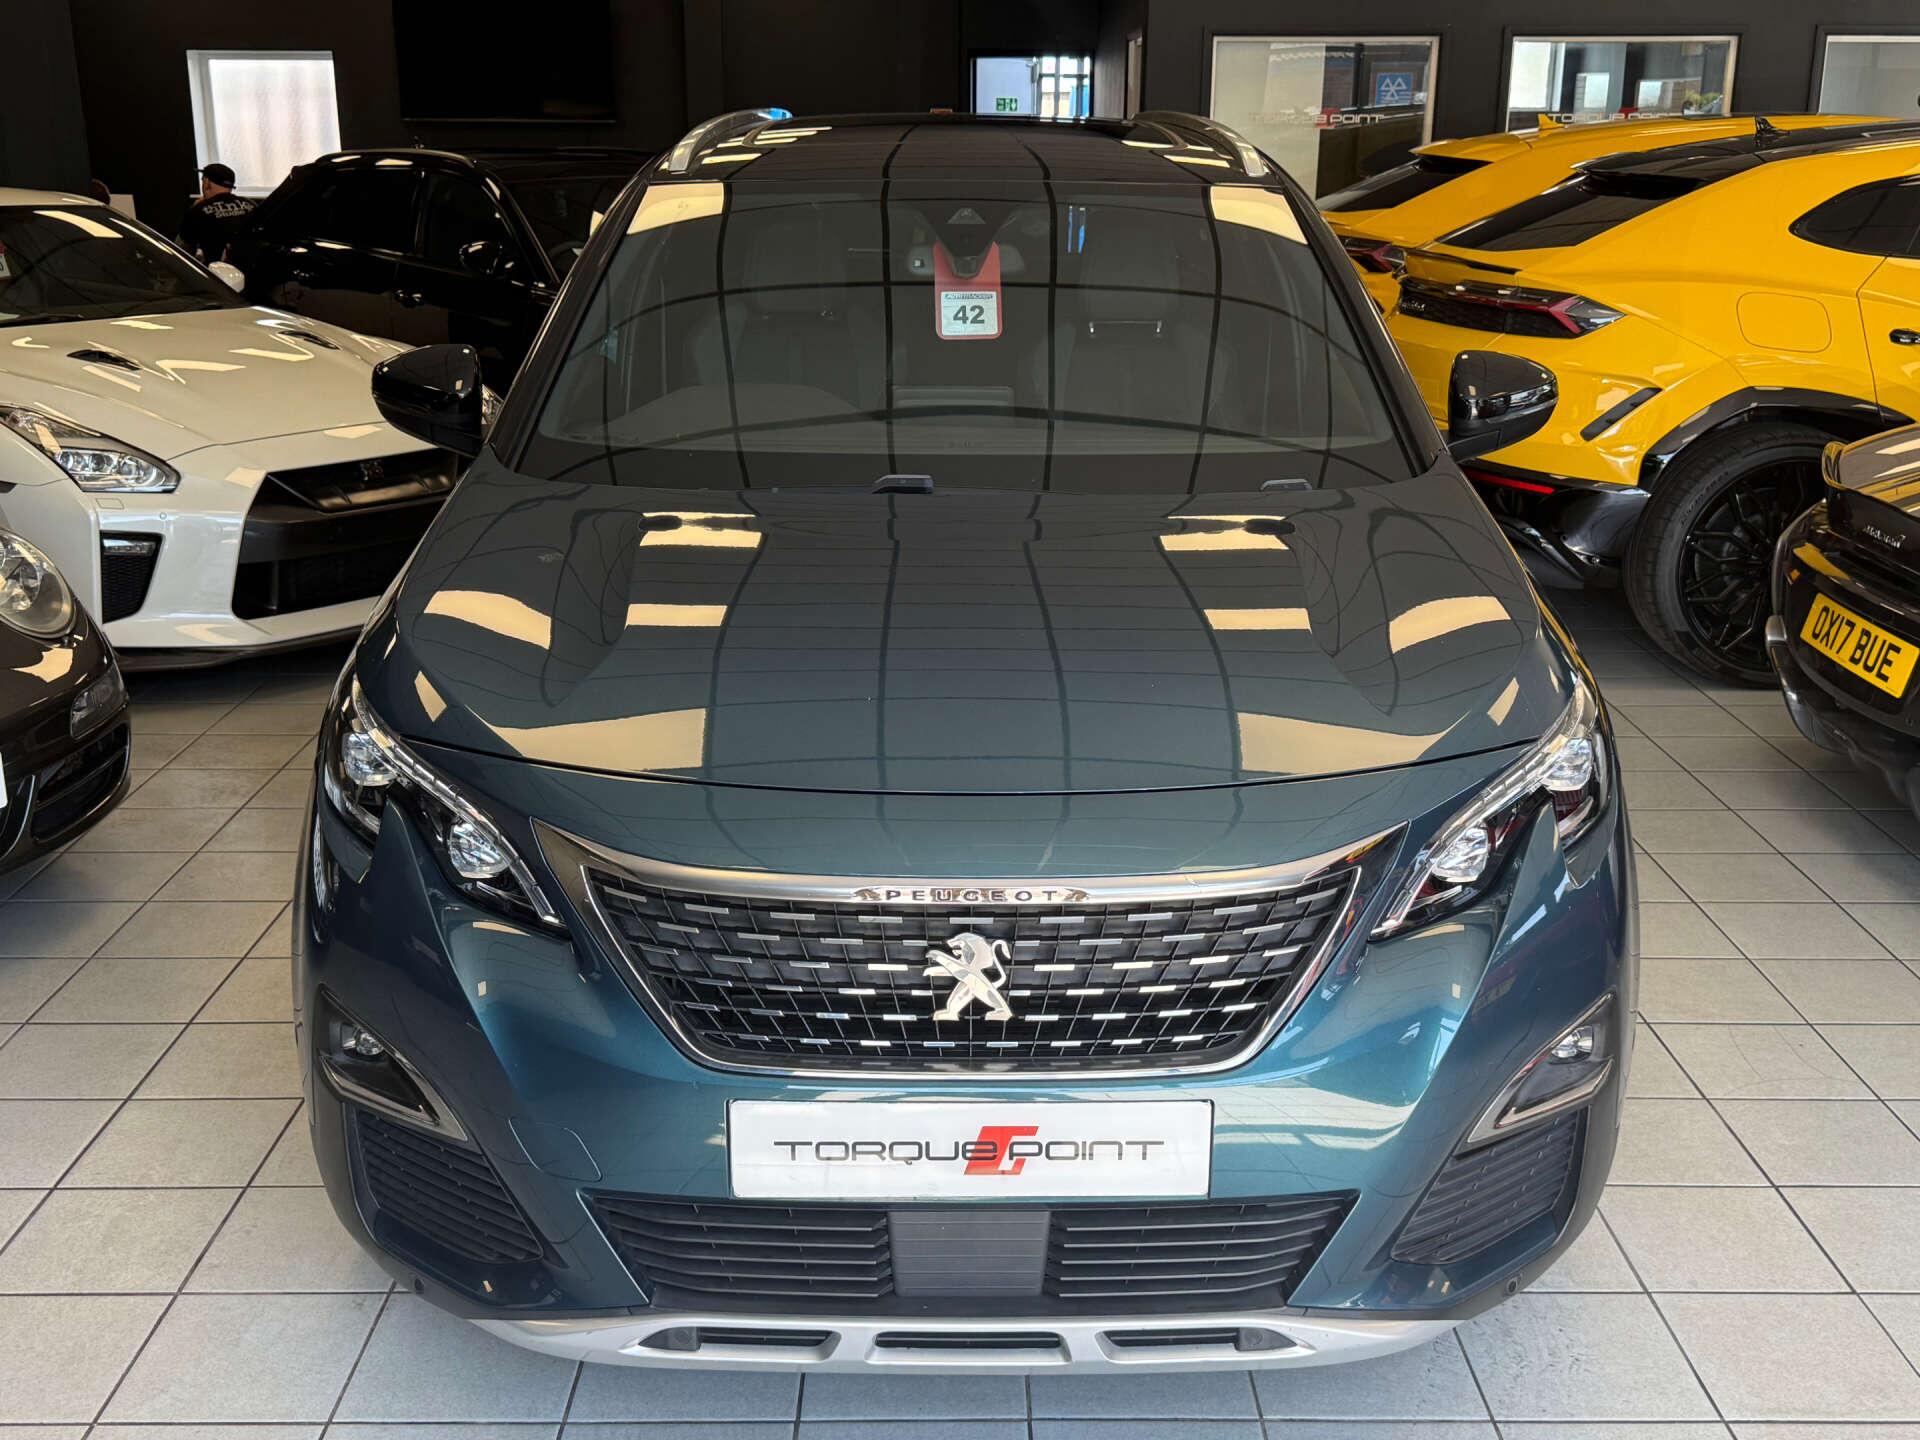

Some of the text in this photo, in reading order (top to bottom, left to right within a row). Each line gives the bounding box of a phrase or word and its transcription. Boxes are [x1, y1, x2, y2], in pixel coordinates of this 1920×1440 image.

[1330, 113, 1384, 124] POINT
[953, 305, 985, 325] 42
[1811, 605, 1902, 683] OX17 BUE
[885, 890, 1058, 902] PEUGEOT
[773, 1140, 1165, 1165] TORQUE POINT
